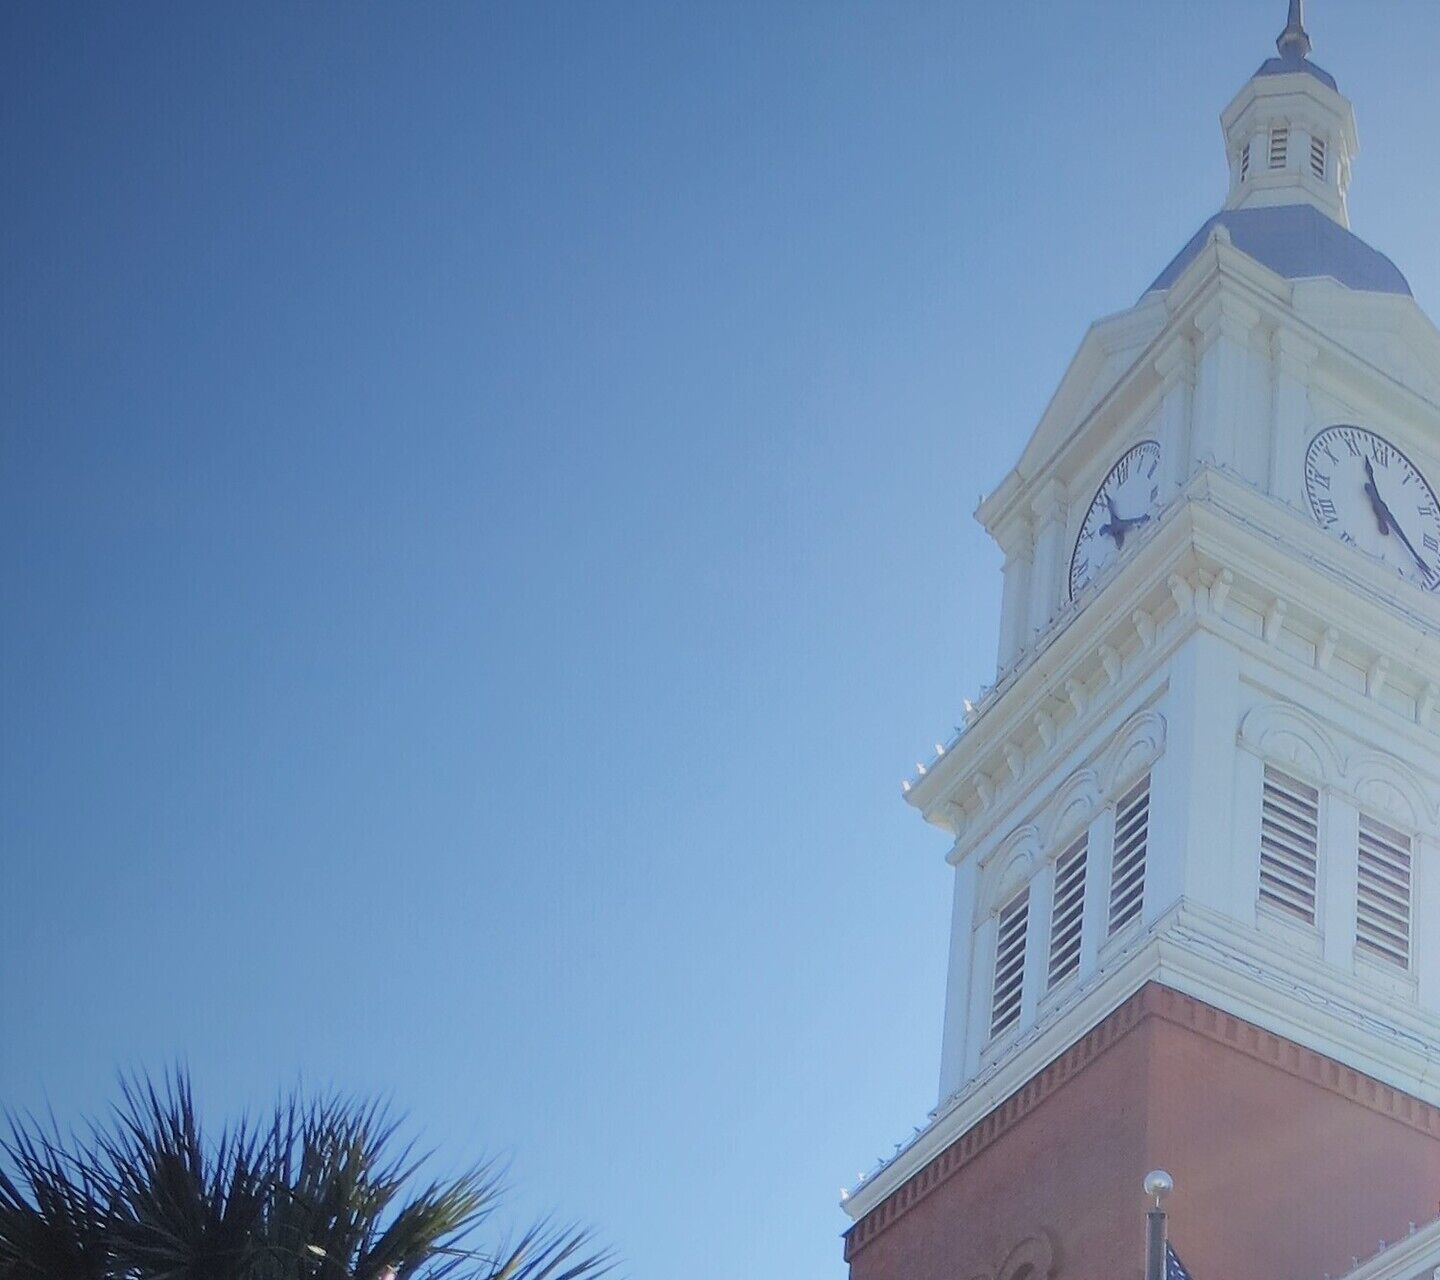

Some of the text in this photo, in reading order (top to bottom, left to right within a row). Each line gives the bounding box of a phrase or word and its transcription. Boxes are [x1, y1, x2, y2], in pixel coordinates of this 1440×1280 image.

[1323, 444, 1339, 466] X
[1371, 437, 1389, 468] XII
[1416, 505, 1433, 517] II
[1422, 532, 1440, 553] III
